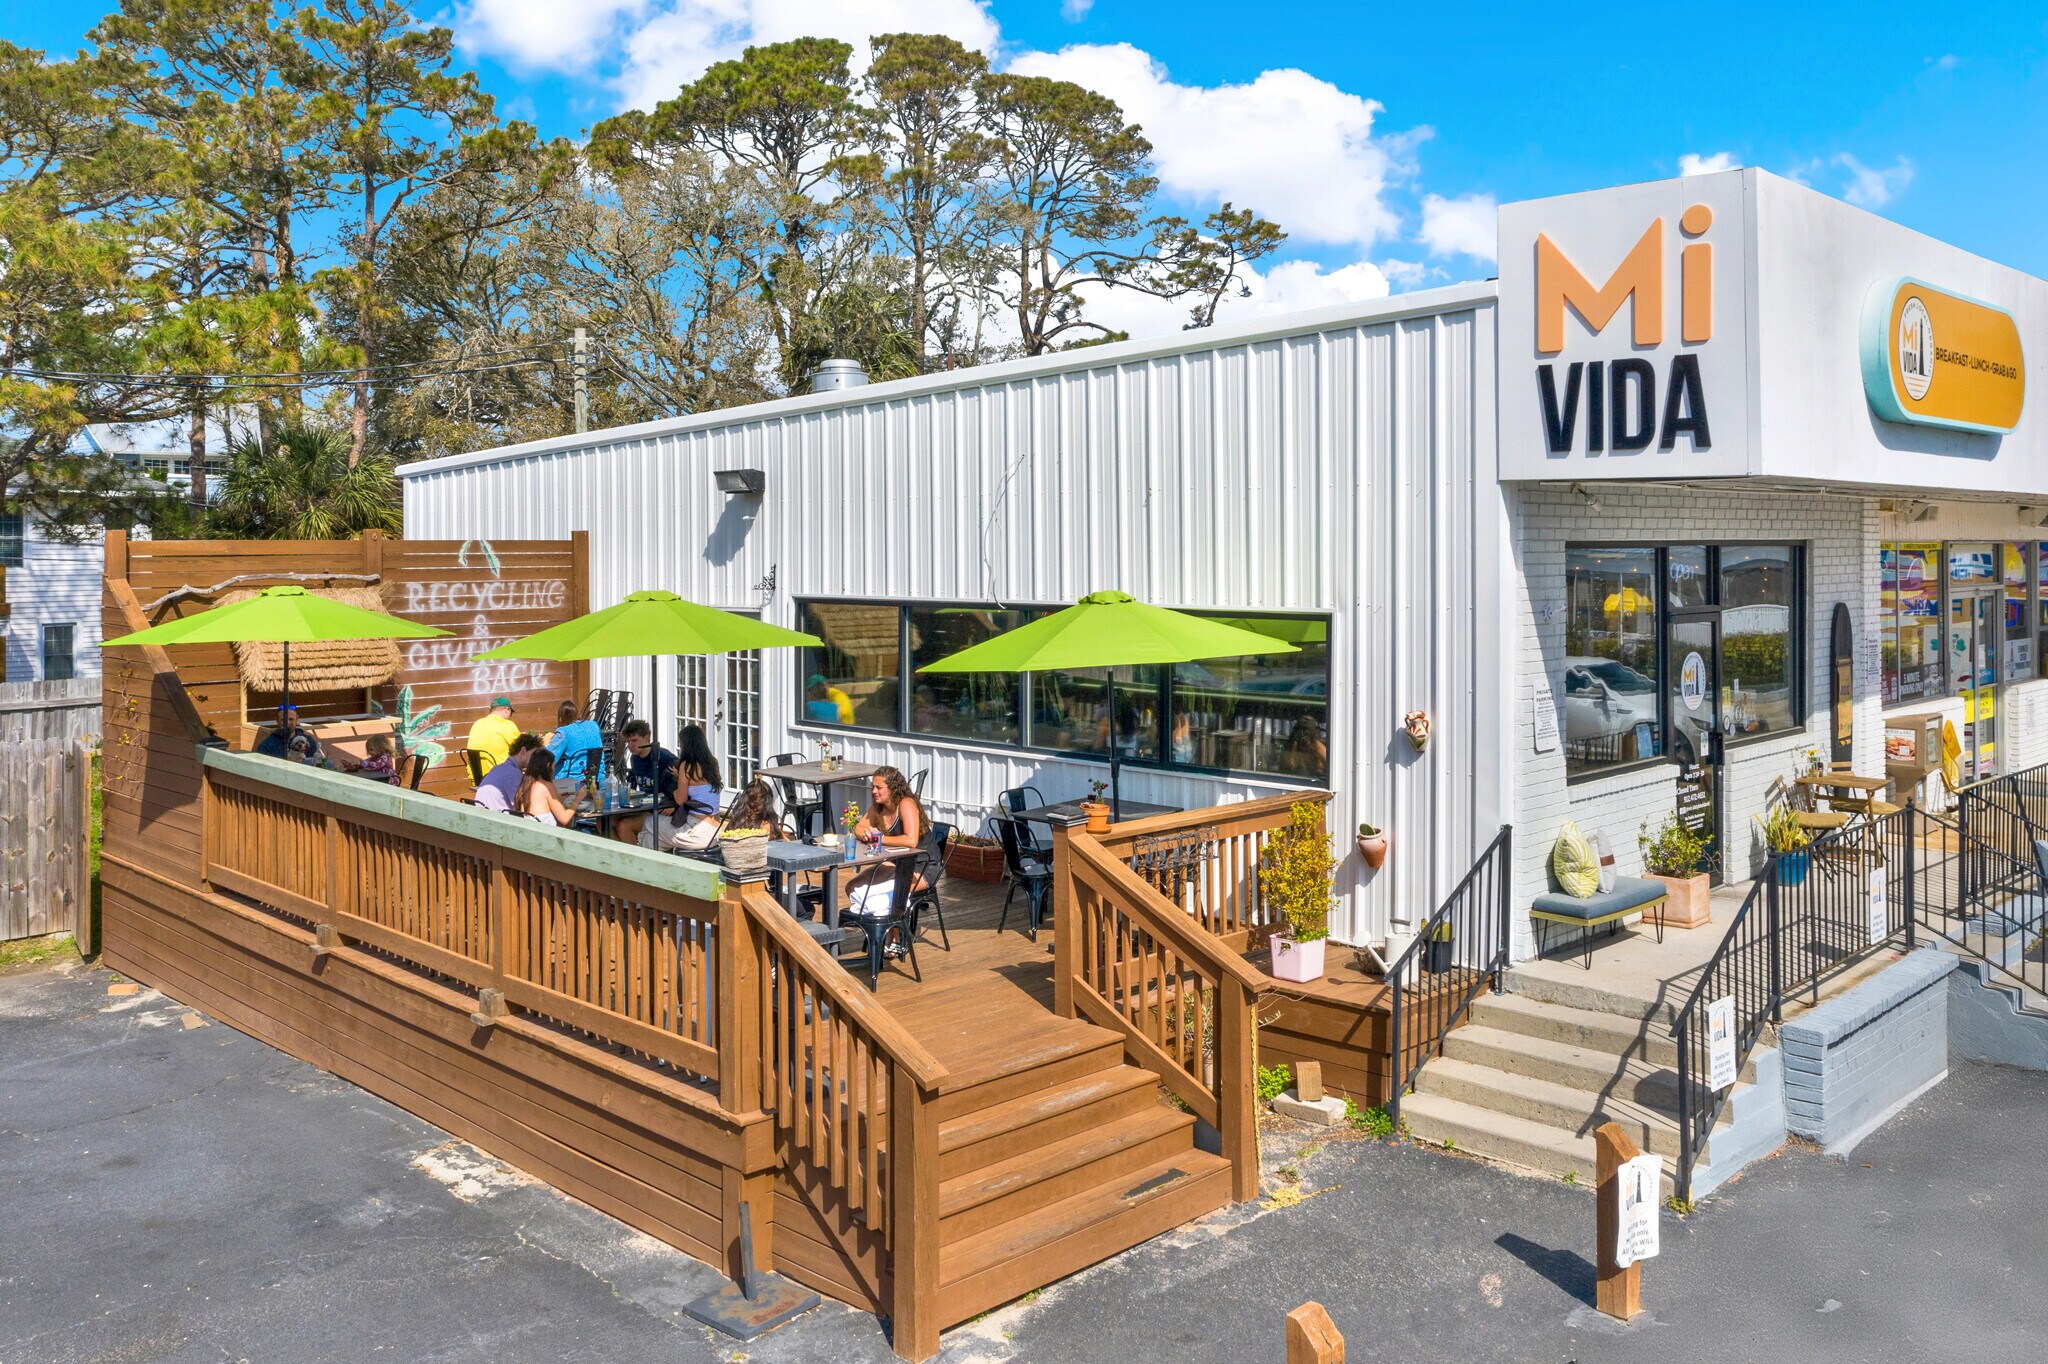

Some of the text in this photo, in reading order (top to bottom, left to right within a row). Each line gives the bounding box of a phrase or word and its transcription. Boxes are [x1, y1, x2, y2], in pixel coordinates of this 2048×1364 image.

[1537, 203, 1713, 353] Mi
[1902, 320, 1918, 352] Mi
[1902, 350, 1918, 375] VIDA
[1935, 346, 1969, 368] BREAKFAST
[1538, 353, 1712, 453] VIDA
[406, 580, 566, 613] RECYCLING
[473, 613, 490, 638] &
[472, 661, 549, 695] BACK
[1683, 664, 1695, 684] Mi
[1906, 671, 1920, 683] MINUTE
[1683, 683, 1695, 697] VIDA
[1900, 683, 1915, 695] PARKING
[1914, 681, 1924, 693] ONLY
[1677, 785, 1690, 795] Closed
[1639, 1237, 1654, 1246] WILL
